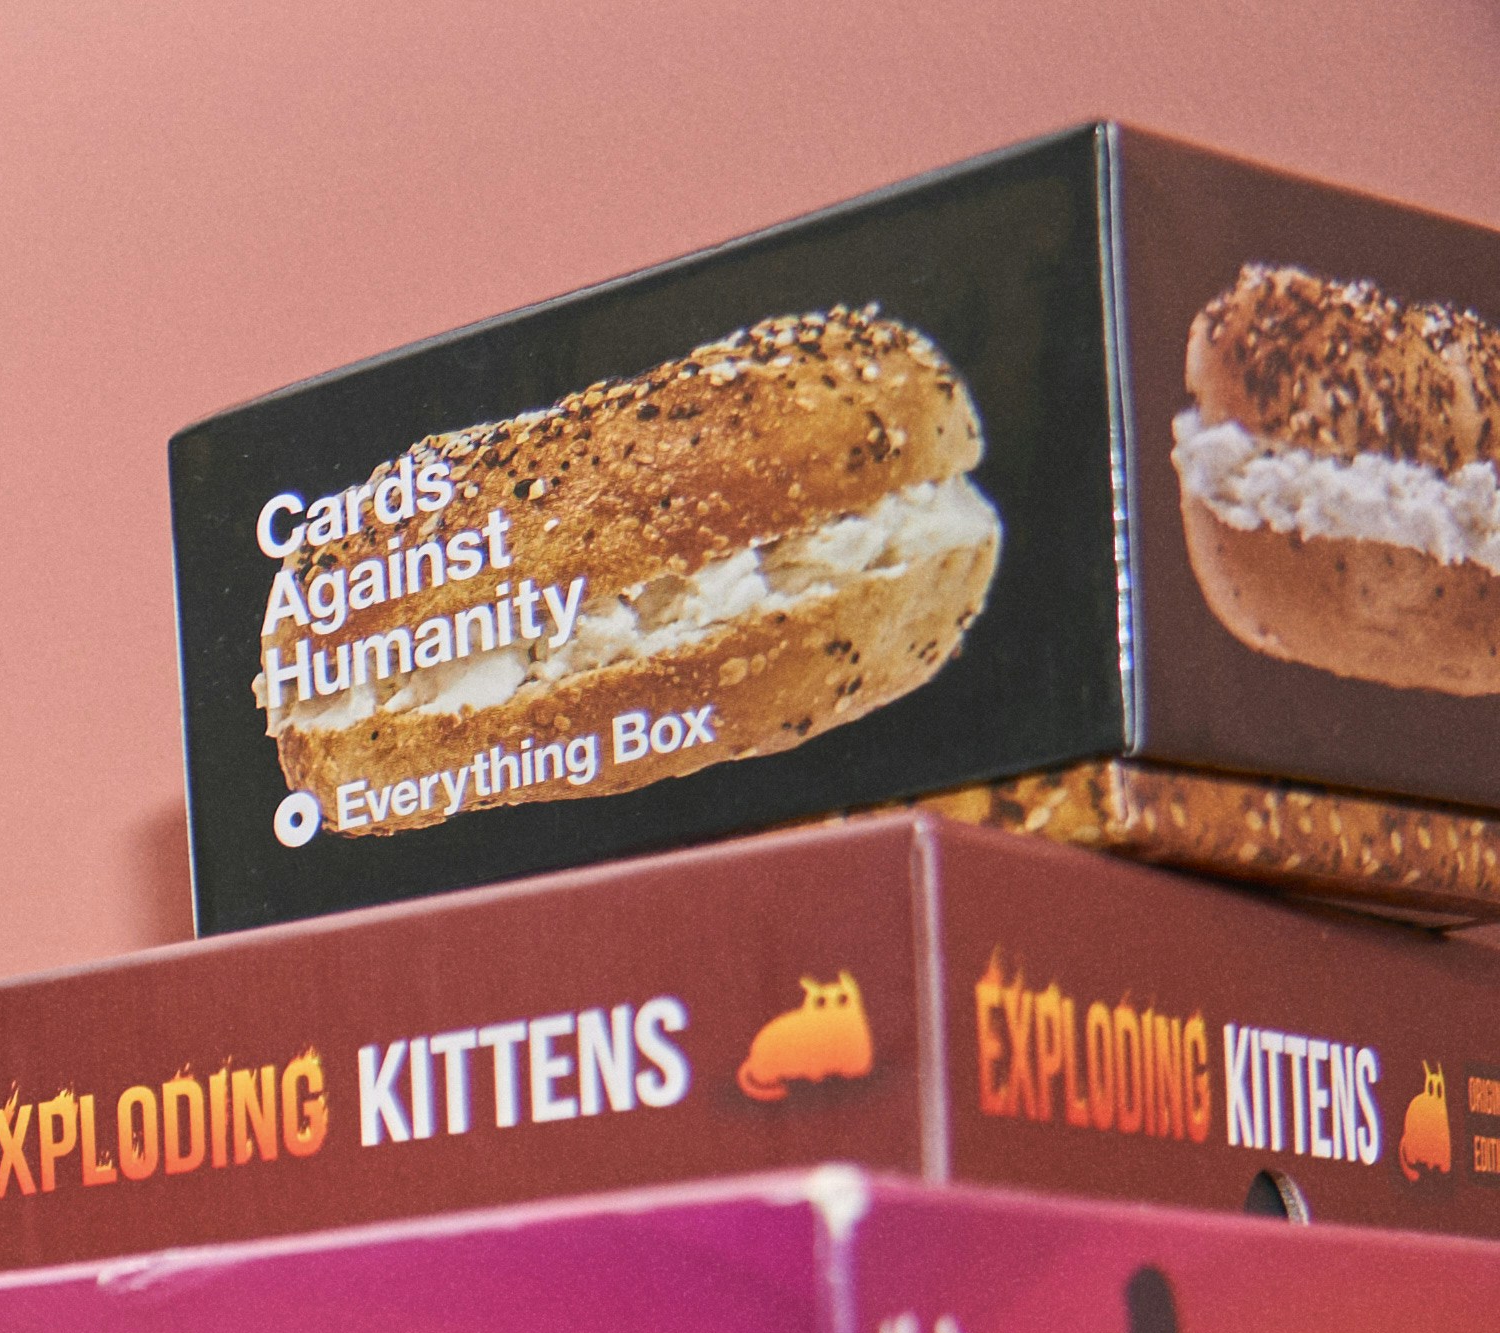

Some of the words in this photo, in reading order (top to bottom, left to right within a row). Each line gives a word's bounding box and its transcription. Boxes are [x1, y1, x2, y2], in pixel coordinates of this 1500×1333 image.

[256, 455, 454, 559] Cards
[261, 509, 513, 637] Against
[263, 574, 586, 711] Humanity
[336, 727, 597, 834] Everything
[612, 703, 717, 766] Box
[357, 996, 690, 1147] KITTENS
[974, 960, 1213, 1144] EXPLODING
[1223, 1022, 1382, 1166] KITTENS
